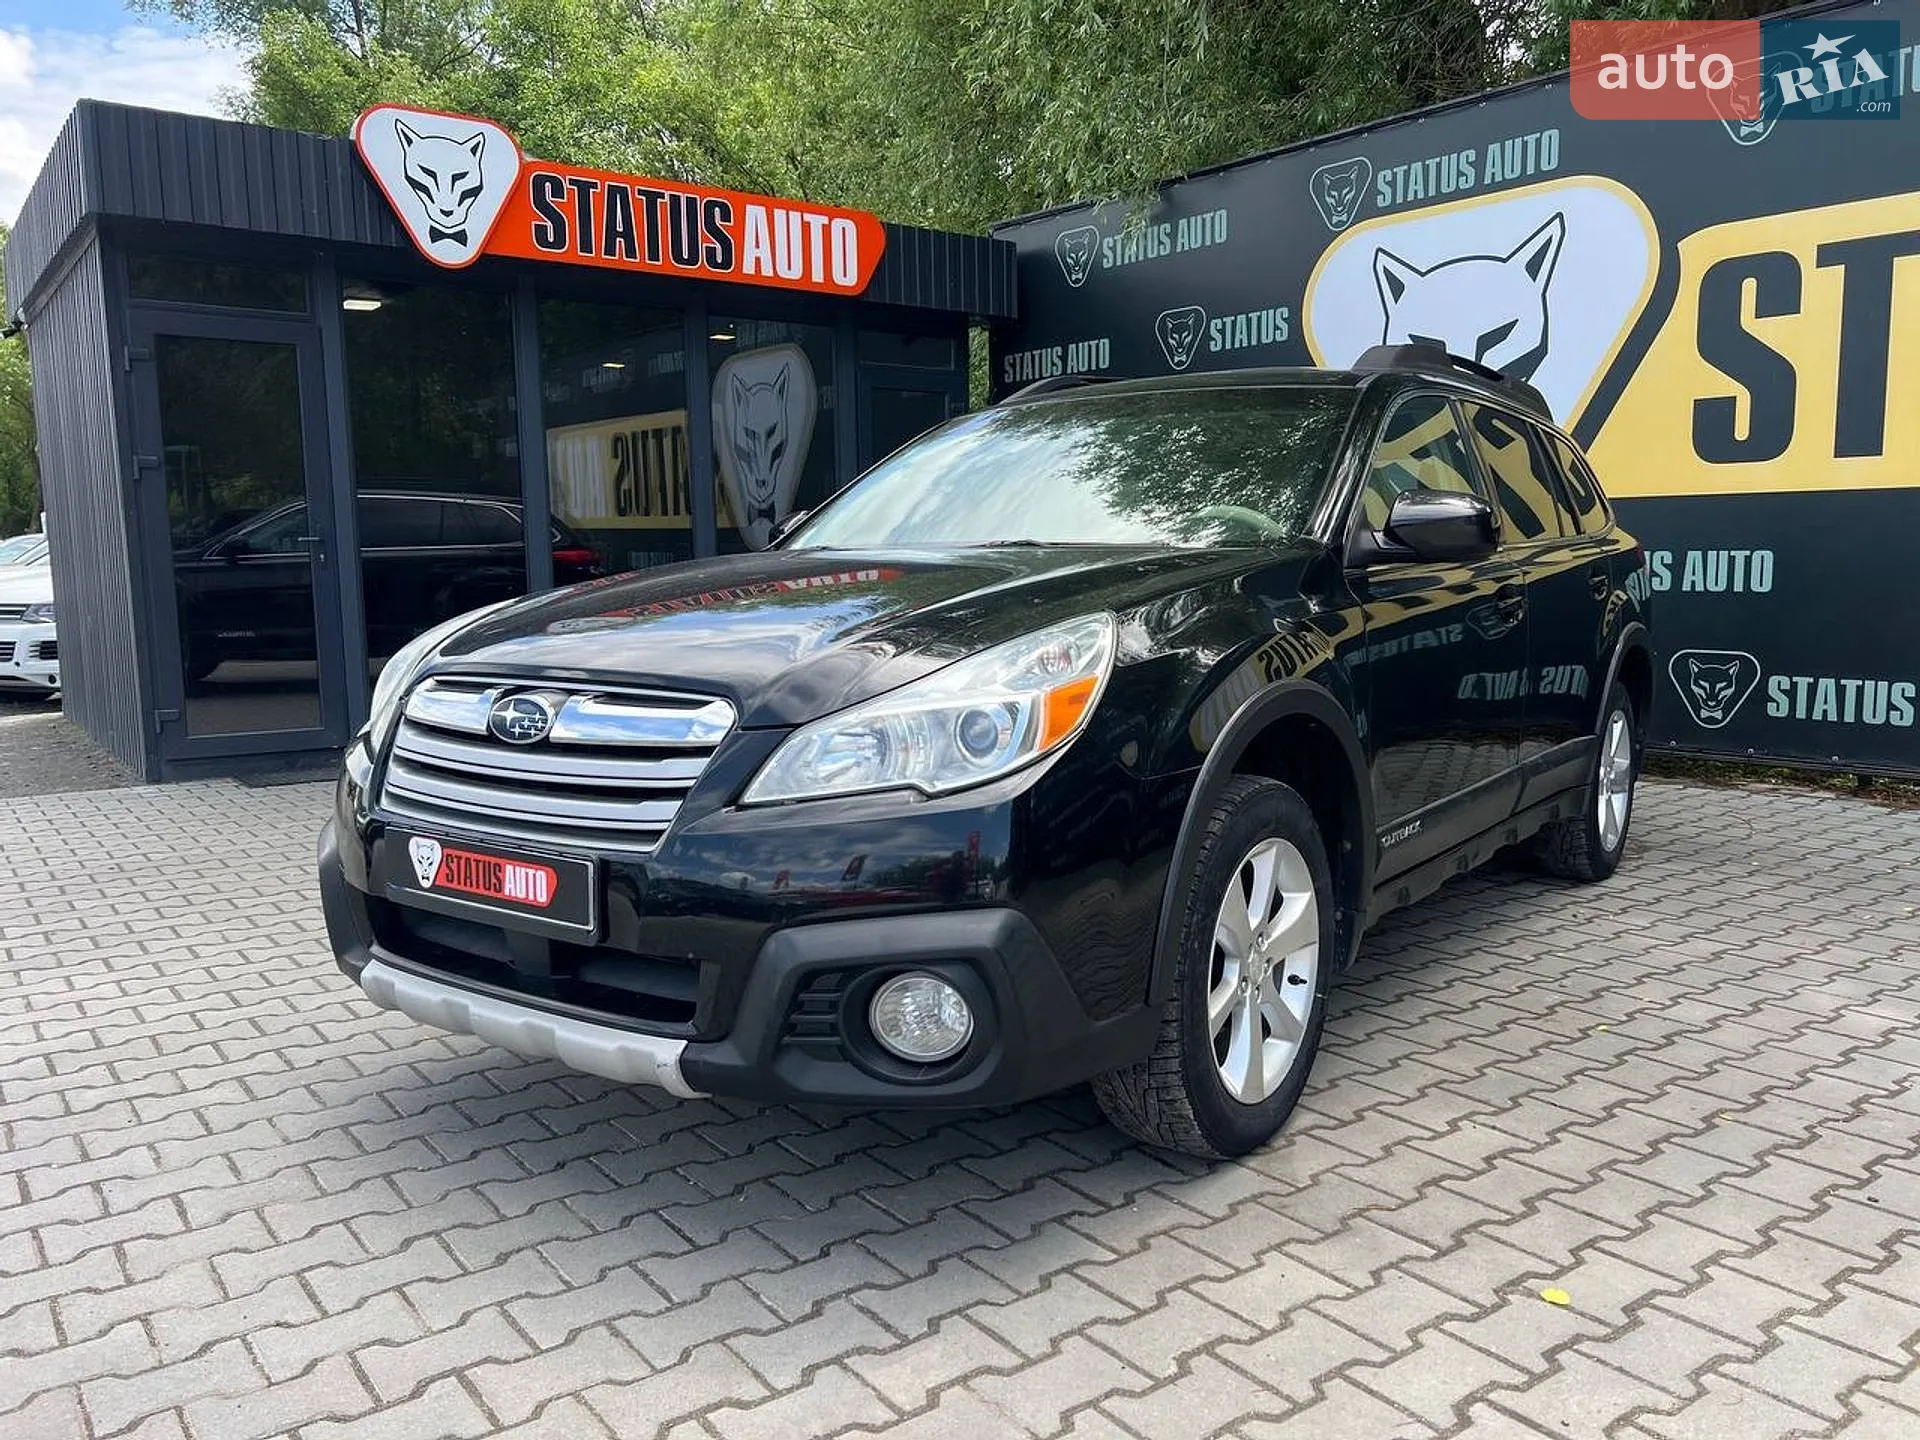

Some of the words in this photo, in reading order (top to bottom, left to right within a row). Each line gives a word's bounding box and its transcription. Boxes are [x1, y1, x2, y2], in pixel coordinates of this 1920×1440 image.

[1376, 149, 1476, 208] STATUS
[1483, 128, 1561, 186] AUTO
[530, 171, 735, 273] STATUS
[742, 203, 858, 287] AUTO
[1102, 222, 1172, 269] STATUS
[1176, 208, 1228, 252] AUTO
[1208, 306, 1289, 352] STATUS
[1004, 345, 1063, 384] STATUS
[1066, 338, 1111, 375] AUTO
[1681, 550, 1774, 593] AUTO
[1767, 675, 1916, 727] STATUS
[446, 853, 502, 894] STATUS
[504, 864, 548, 903] AUTO
